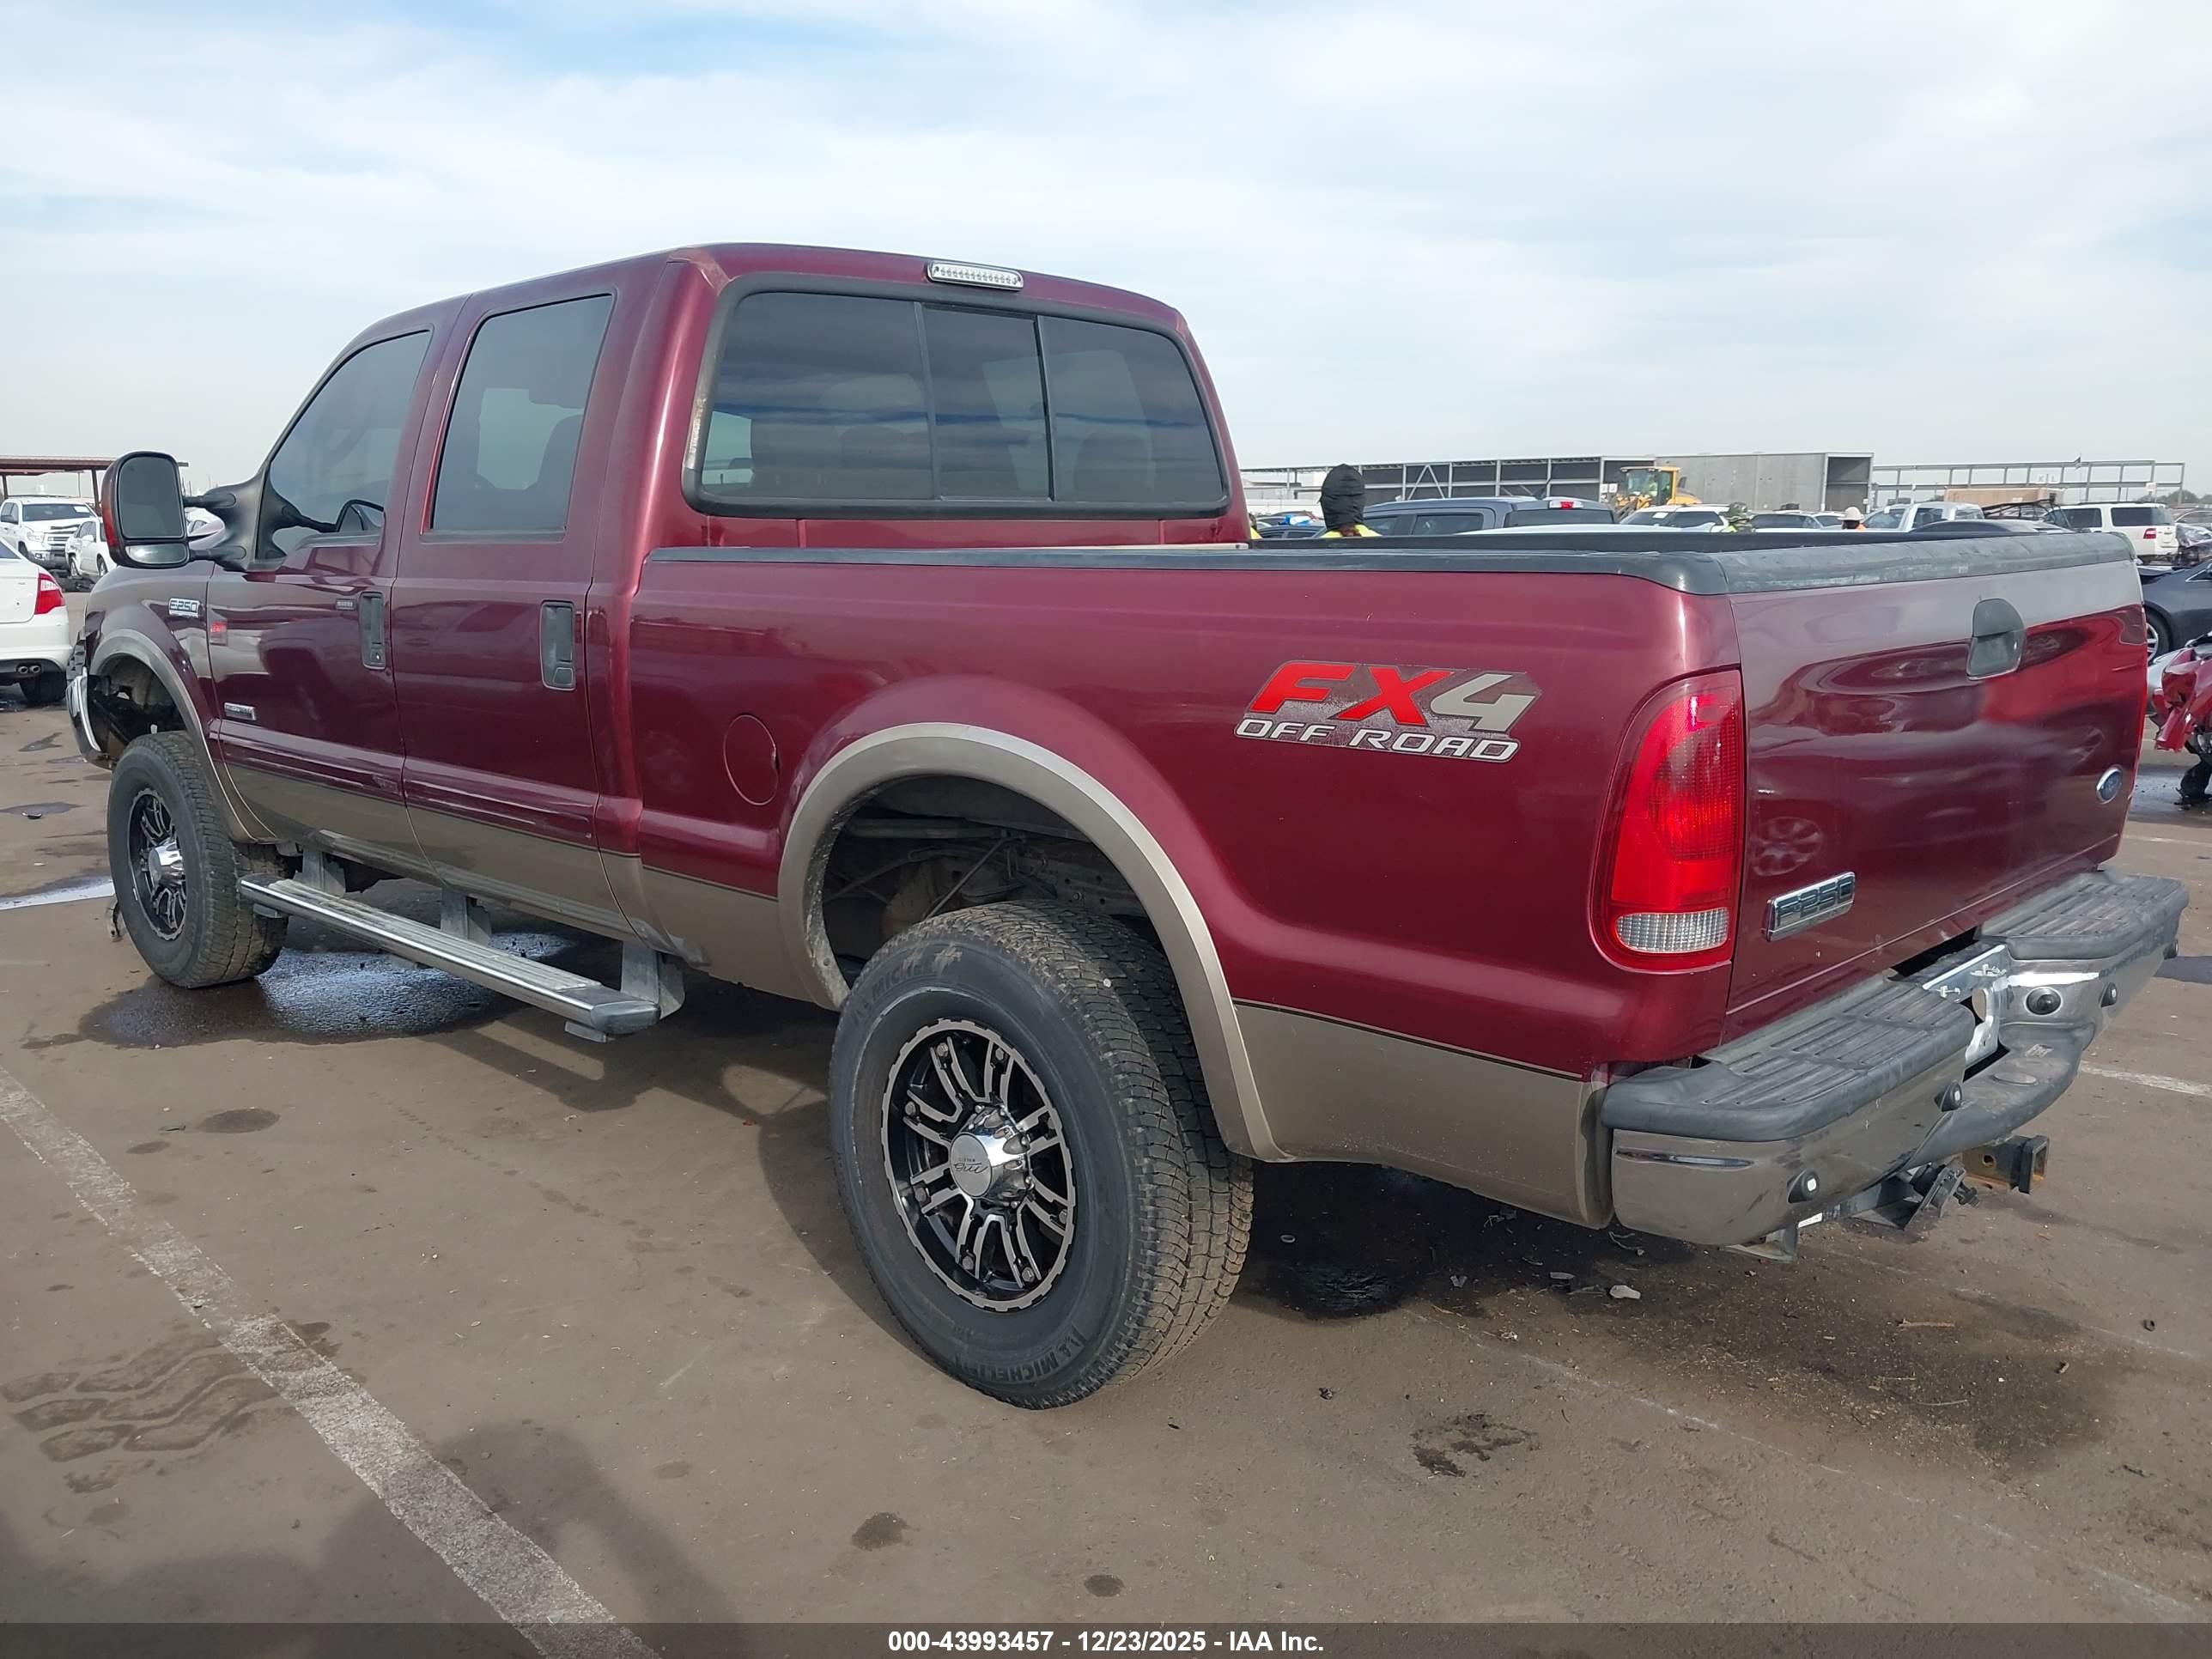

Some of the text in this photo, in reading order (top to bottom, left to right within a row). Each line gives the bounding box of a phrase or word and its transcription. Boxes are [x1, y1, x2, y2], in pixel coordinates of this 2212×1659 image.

[169, 599, 198, 614] F-250
[1249, 661, 1536, 733] FX4
[1235, 719, 1521, 763] OFF ROAD
[1775, 875, 1856, 927] F-250
